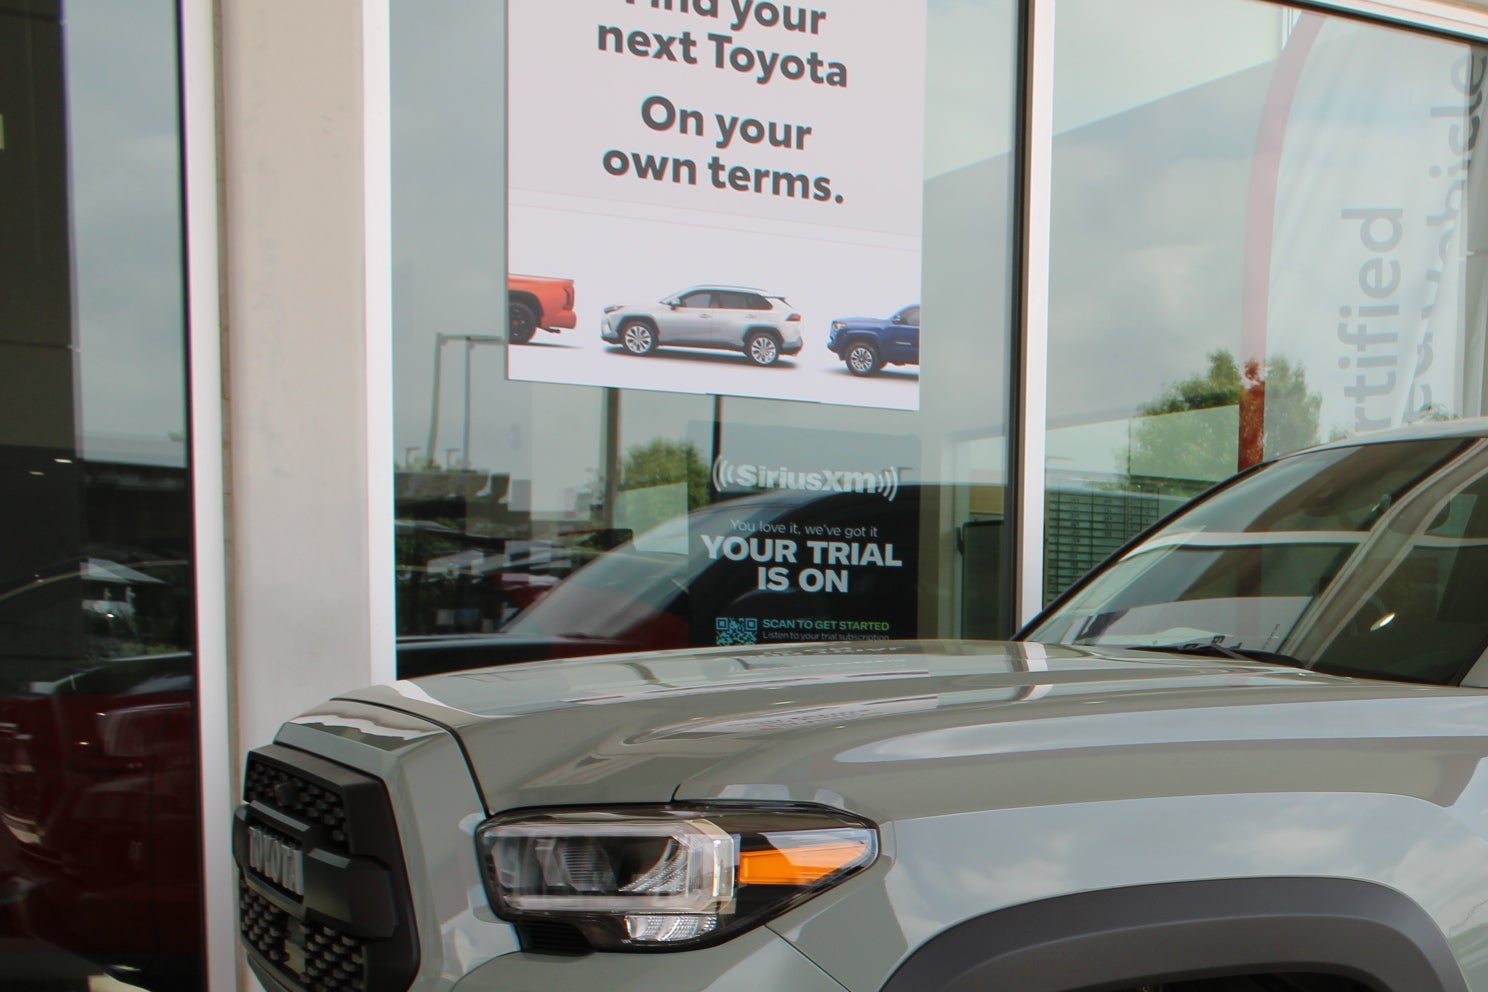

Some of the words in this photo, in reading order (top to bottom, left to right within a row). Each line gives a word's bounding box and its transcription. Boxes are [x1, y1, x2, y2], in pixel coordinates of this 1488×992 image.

[730, 0, 827, 35] your
[598, 24, 698, 65] next
[707, 33, 848, 87] Toyota
[641, 95, 704, 136] On
[715, 113, 812, 150] your
[602, 148, 696, 185] own
[708, 156, 844, 204] terms.
[730, 519, 756, 532] You
[760, 521, 786, 534] love
[804, 524, 841, 536] we've
[845, 526, 866, 539] got
[870, 525, 878, 538] it
[701, 535, 797, 563] YOUR
[807, 540, 903, 567] TRIAL
[757, 566, 790, 591] IS
[799, 568, 848, 593] ON
[762, 619, 796, 629] SCAN
[797, 619, 813, 629] TO
[815, 620, 837, 630] GET
[839, 621, 890, 631] STARTED
